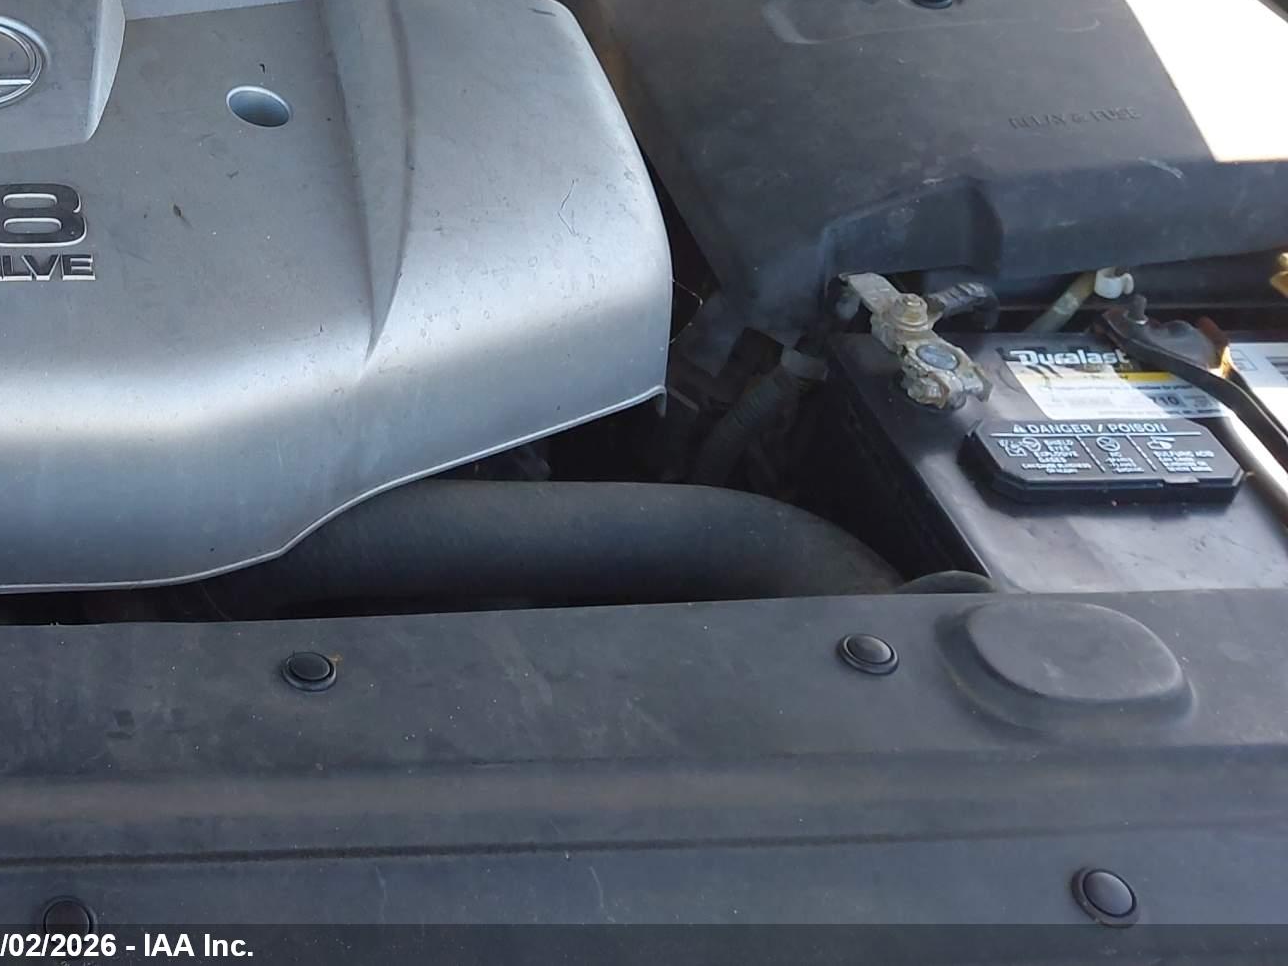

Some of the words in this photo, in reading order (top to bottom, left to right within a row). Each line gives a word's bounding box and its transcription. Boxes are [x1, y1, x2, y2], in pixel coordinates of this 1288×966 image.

[1010, 348, 1131, 366] Duralast
[1026, 423, 1094, 434] DANGER
[1109, 423, 1168, 433] POISON
